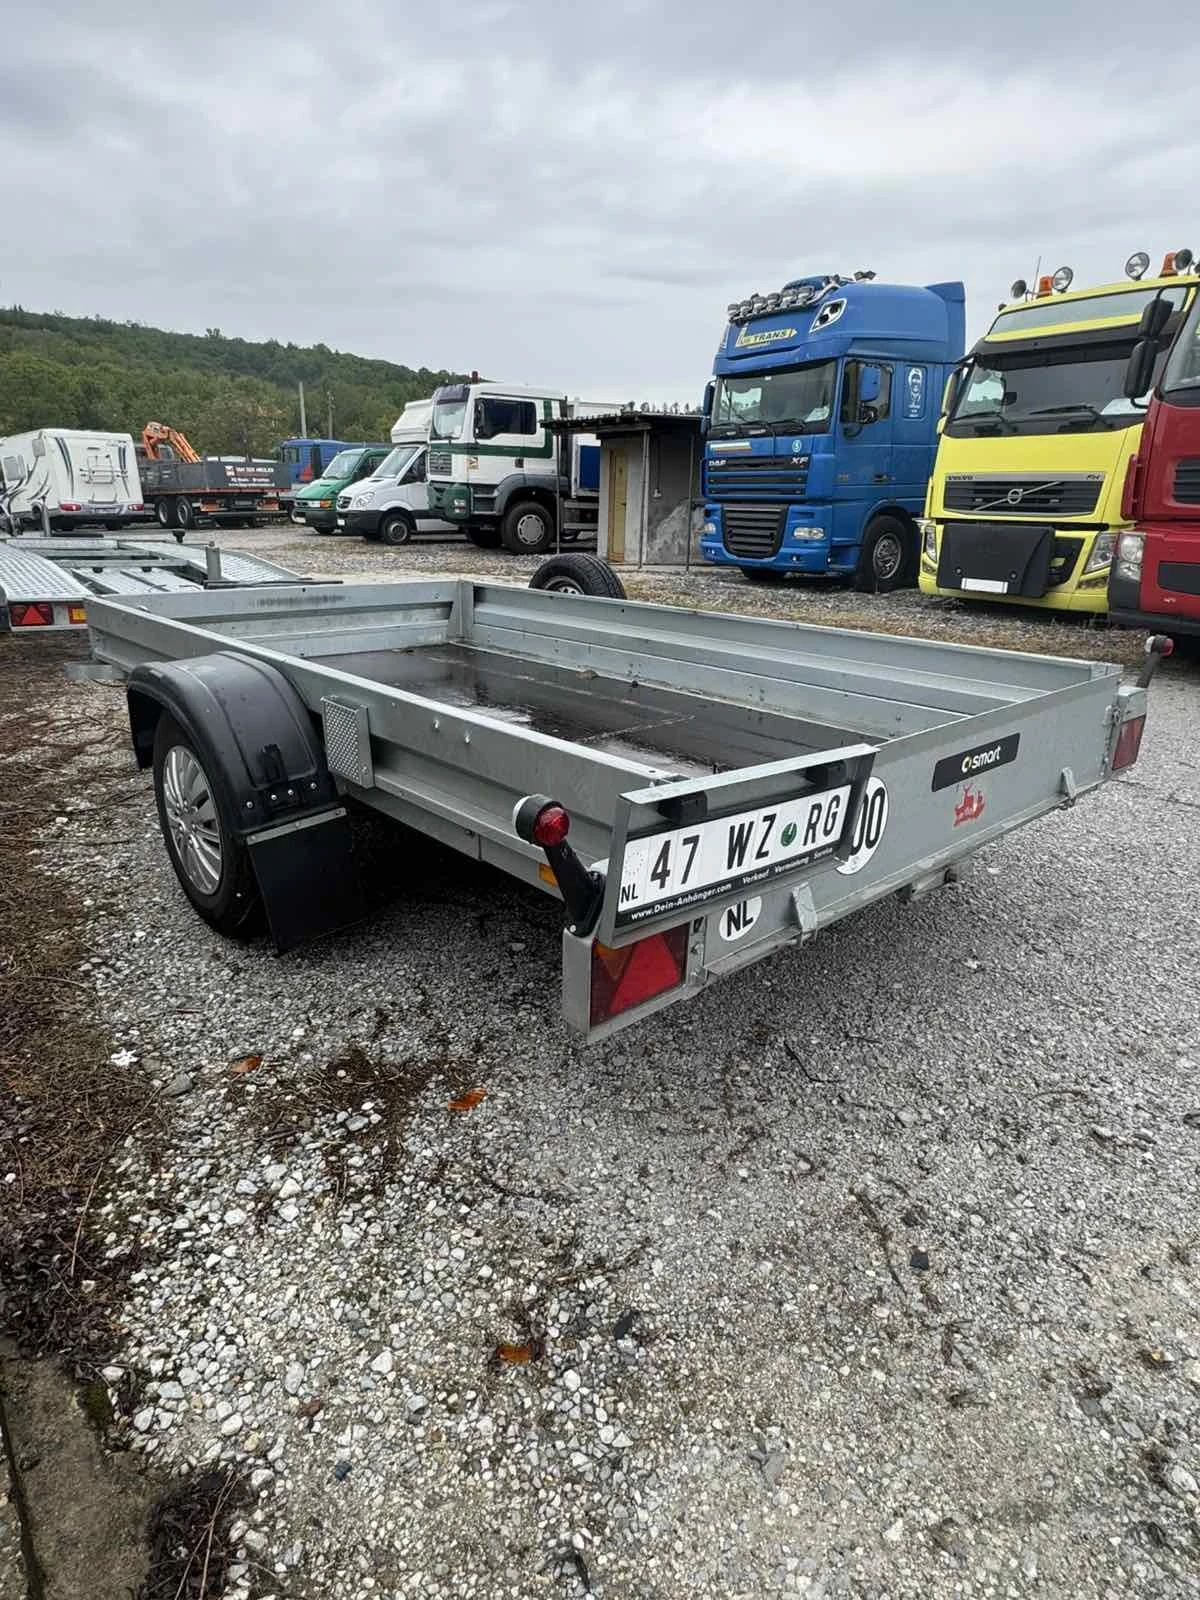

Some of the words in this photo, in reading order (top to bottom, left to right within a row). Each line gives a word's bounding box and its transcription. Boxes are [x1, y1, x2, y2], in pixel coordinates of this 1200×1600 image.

[754, 329, 786, 343] TRANS
[972, 745, 1001, 769] smart
[650, 834, 700, 890] 47
[727, 813, 777, 870] WZ
[803, 794, 841, 846] RG
[742, 869, 770, 884] Verkauf
[620, 883, 639, 904] NL
[727, 900, 754, 938] NL
